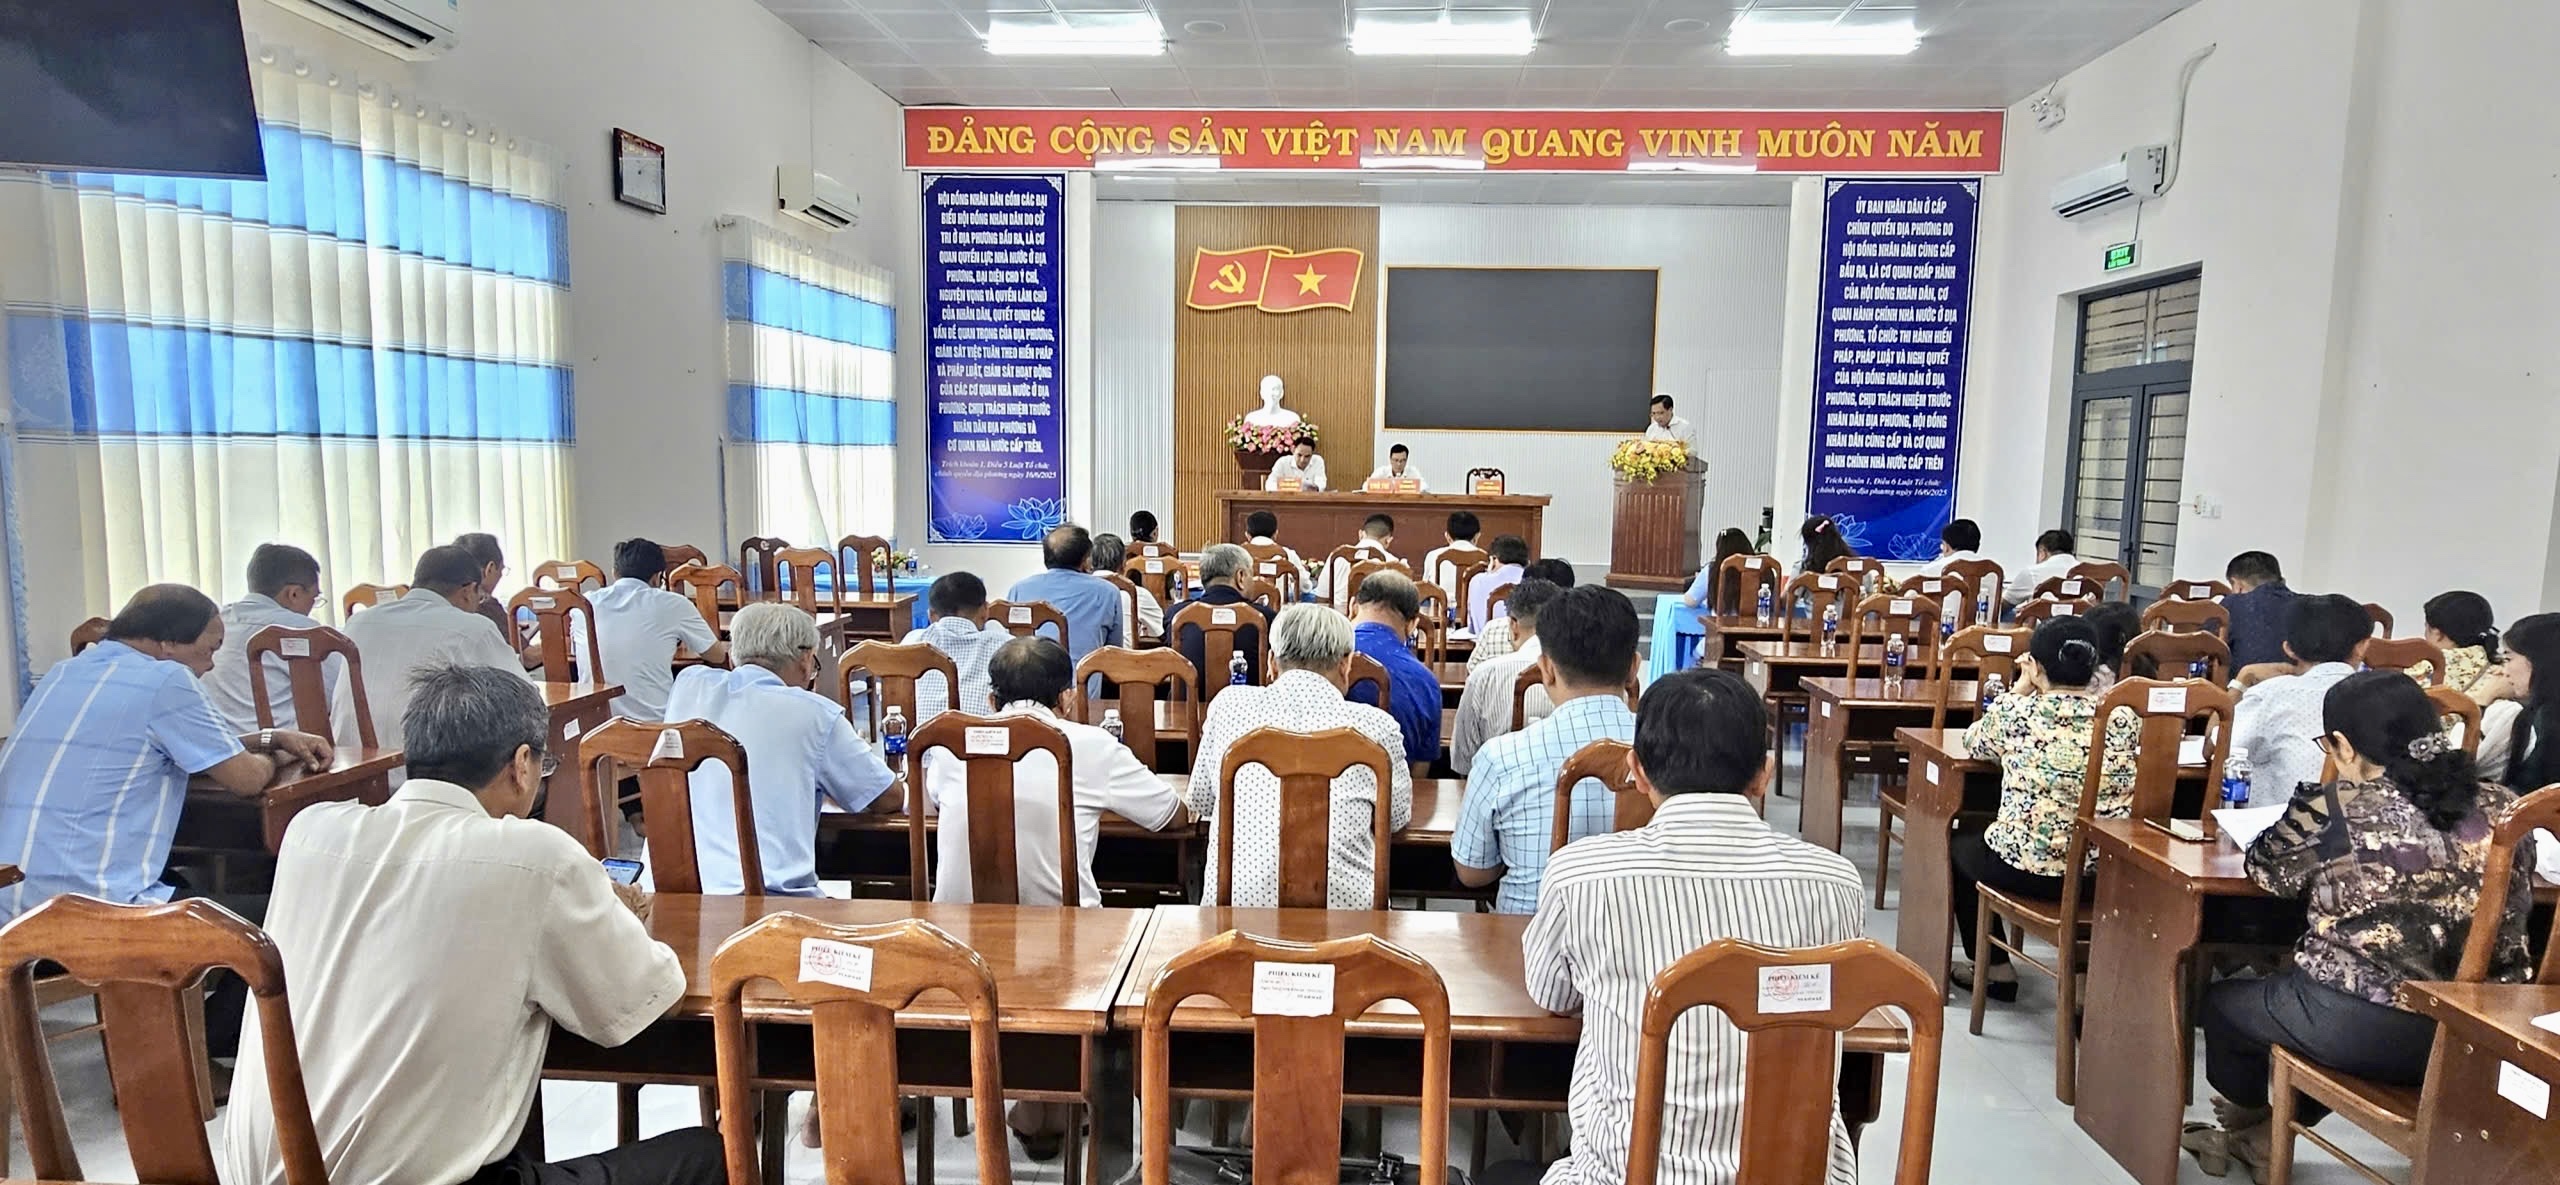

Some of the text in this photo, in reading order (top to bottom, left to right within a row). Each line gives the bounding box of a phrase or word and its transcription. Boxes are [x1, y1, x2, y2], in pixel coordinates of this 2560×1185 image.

[927, 116, 1984, 164] ĐẢNG CỘNG SẢN VIỆT NAM QUANG VINH MUÔN NĂM
[1867, 200, 1884, 213] BAN
[1884, 198, 1905, 214] NHÂN
[1907, 198, 1922, 214] DÂN
[1924, 196, 1930, 214] Ở
[1931, 196, 1947, 214] CẤP
[1847, 218, 1953, 238] CHÍNH QUYỀN ĐỊA PHƯƠNG DO
[1842, 240, 1956, 259] HỘI ĐỒNG NHÂN DÂN CÙNG CẤP
[1839, 261, 1855, 278] BẦU
[1870, 263, 1879, 278] LÀ
[1880, 264, 1892, 279] CƠ
[1892, 265, 1912, 280] QUAN
[1913, 262, 1934, 279] CHẤP
[1934, 263, 1956, 279] HÀNH
[1844, 282, 1859, 300] CỦA
[1860, 284, 1873, 302] HỘI
[1874, 283, 1895, 300] ĐỒNG
[1896, 284, 1917, 300] NHÂN
[1938, 286, 1949, 300] CƠ
[1832, 305, 1957, 325] QUAN HÀNH CHÍNH NHÀ NƯỚC Ở ĐỊA
[1868, 324, 1877, 342] TỔ
[1878, 327, 1898, 343] CHỨC
[1900, 330, 1912, 343] THI
[1912, 328, 1933, 343] HÀNH
[1934, 327, 1952, 344] HIẾN
[1855, 350, 1875, 364] PHÁP
[1876, 349, 1895, 367] LUẬT
[1896, 350, 1906, 364] VÀ
[1907, 352, 1925, 367] NGHỊ
[1926, 348, 1950, 366] QUYẾT
[1835, 368, 1945, 389] CỦA HỘI ĐỒNG NHÂN DÂN Ở ĐỊA
[1858, 392, 1876, 409] CHỊU
[1877, 391, 1901, 406] TRÁCH
[1902, 391, 1926, 409] NHIỆM
[1928, 391, 1951, 407] TRƯỚC
[1827, 411, 1848, 426] NHÂN
[1848, 411, 1864, 426] DÂN
[1865, 414, 1879, 429] ĐỊA
[1913, 412, 1926, 430] HỘI
[1926, 412, 1948, 429] ĐỒNG
[1826, 431, 1945, 450] NHÂN DÂN CÙNG CẤP VÀ CƠ QUAN
[1825, 453, 1944, 470] HÀNH CHÍNH NHÀ NƯỚC CẤP TRÊN
